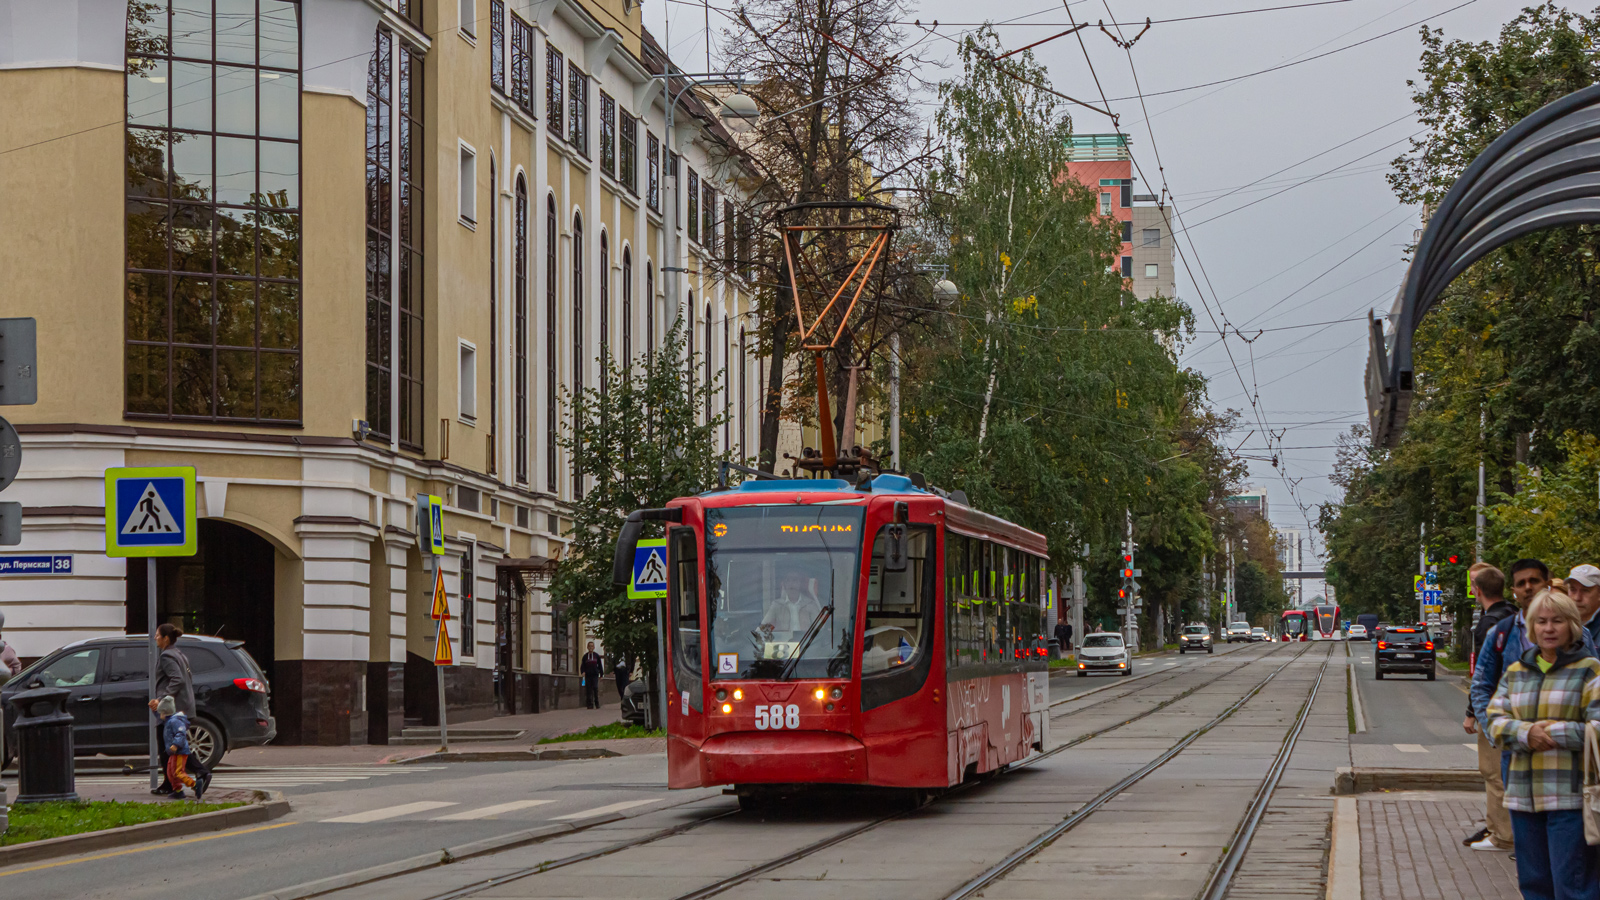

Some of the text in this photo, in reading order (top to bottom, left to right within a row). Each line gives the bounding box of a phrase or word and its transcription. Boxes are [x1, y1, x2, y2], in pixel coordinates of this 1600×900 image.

[0, 559, 70, 570] ул. Пермская 38
[772, 644, 789, 659] 8
[754, 704, 800, 730] 588
